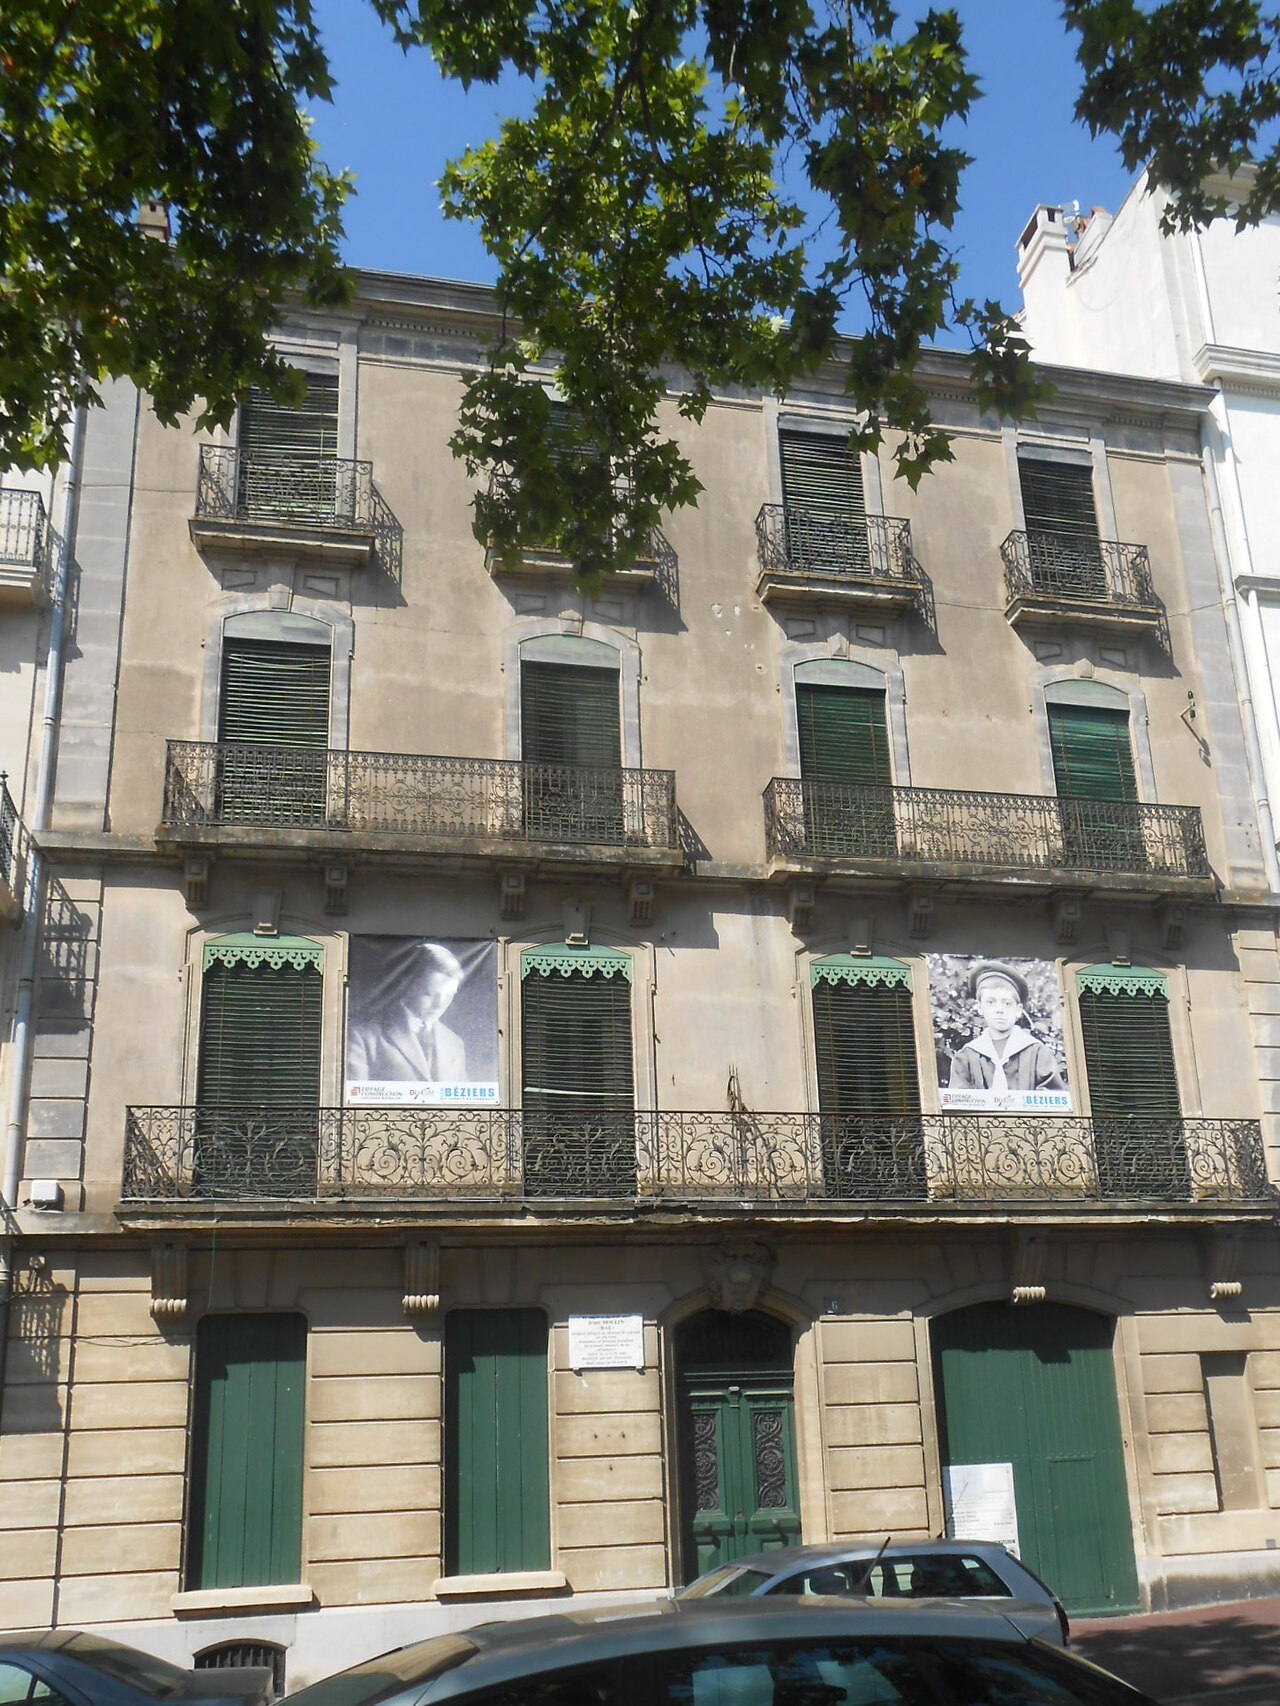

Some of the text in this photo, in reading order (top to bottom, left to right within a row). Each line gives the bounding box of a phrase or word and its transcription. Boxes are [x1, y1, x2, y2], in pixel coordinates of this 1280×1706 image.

[445, 1086, 495, 1097] BÉZIERS
[1026, 1095, 1068, 1105] BÉZIERS
[832, 1300, 838, 1310] 6
